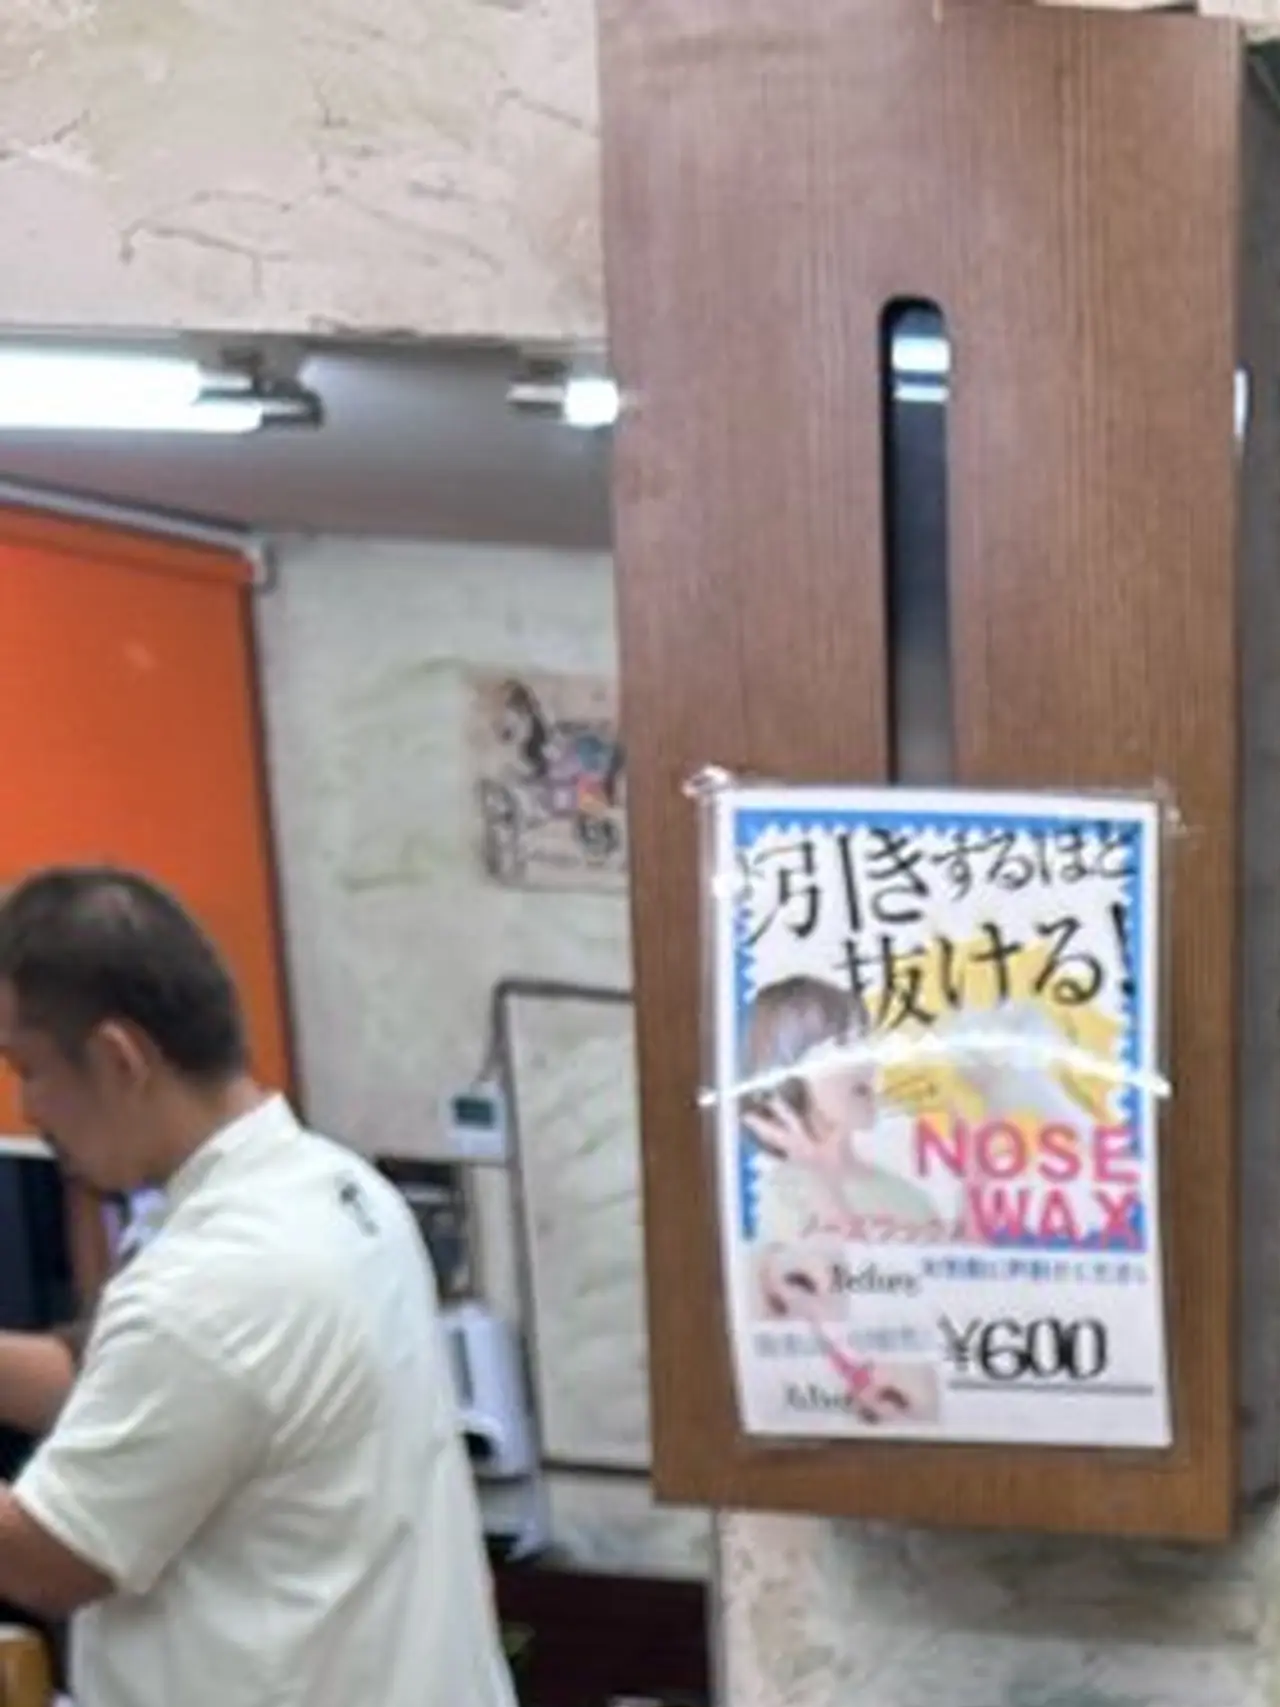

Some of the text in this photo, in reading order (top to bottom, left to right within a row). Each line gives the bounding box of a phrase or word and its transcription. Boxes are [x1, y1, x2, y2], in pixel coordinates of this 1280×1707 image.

[916, 1118, 1142, 1183] NOSE
[968, 1187, 1147, 1250] WAX
[938, 1313, 1108, 1381] ¥600
